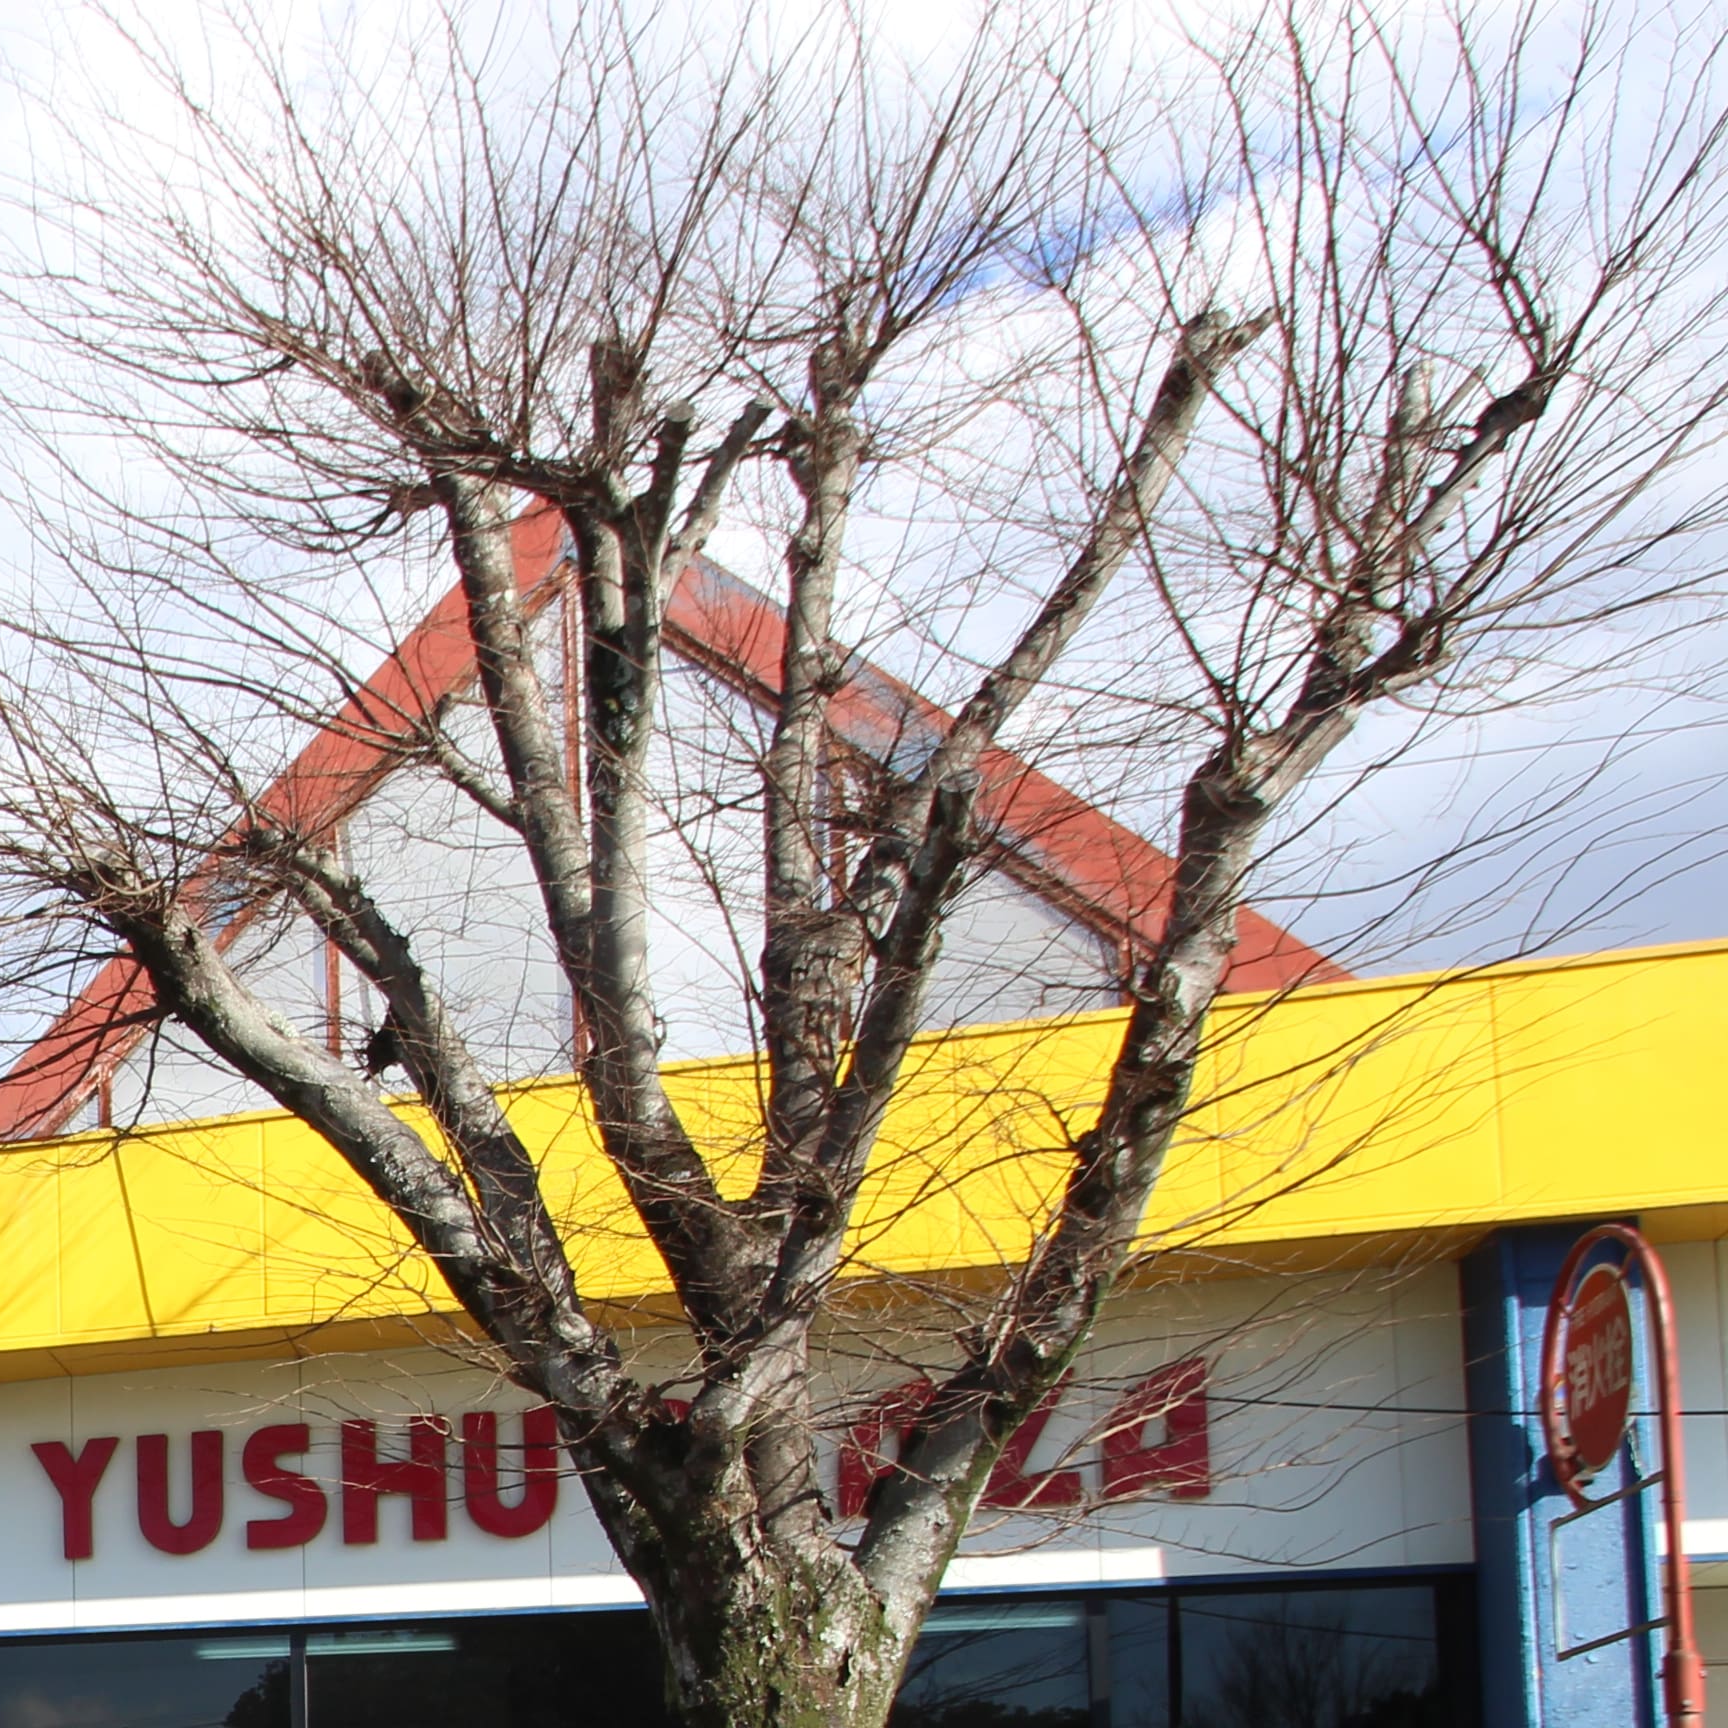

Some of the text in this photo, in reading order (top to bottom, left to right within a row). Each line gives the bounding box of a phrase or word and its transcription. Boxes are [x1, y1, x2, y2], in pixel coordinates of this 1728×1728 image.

[1568, 1315, 1628, 1420] 消火栓
[30, 1403, 558, 1560] YUSHU
